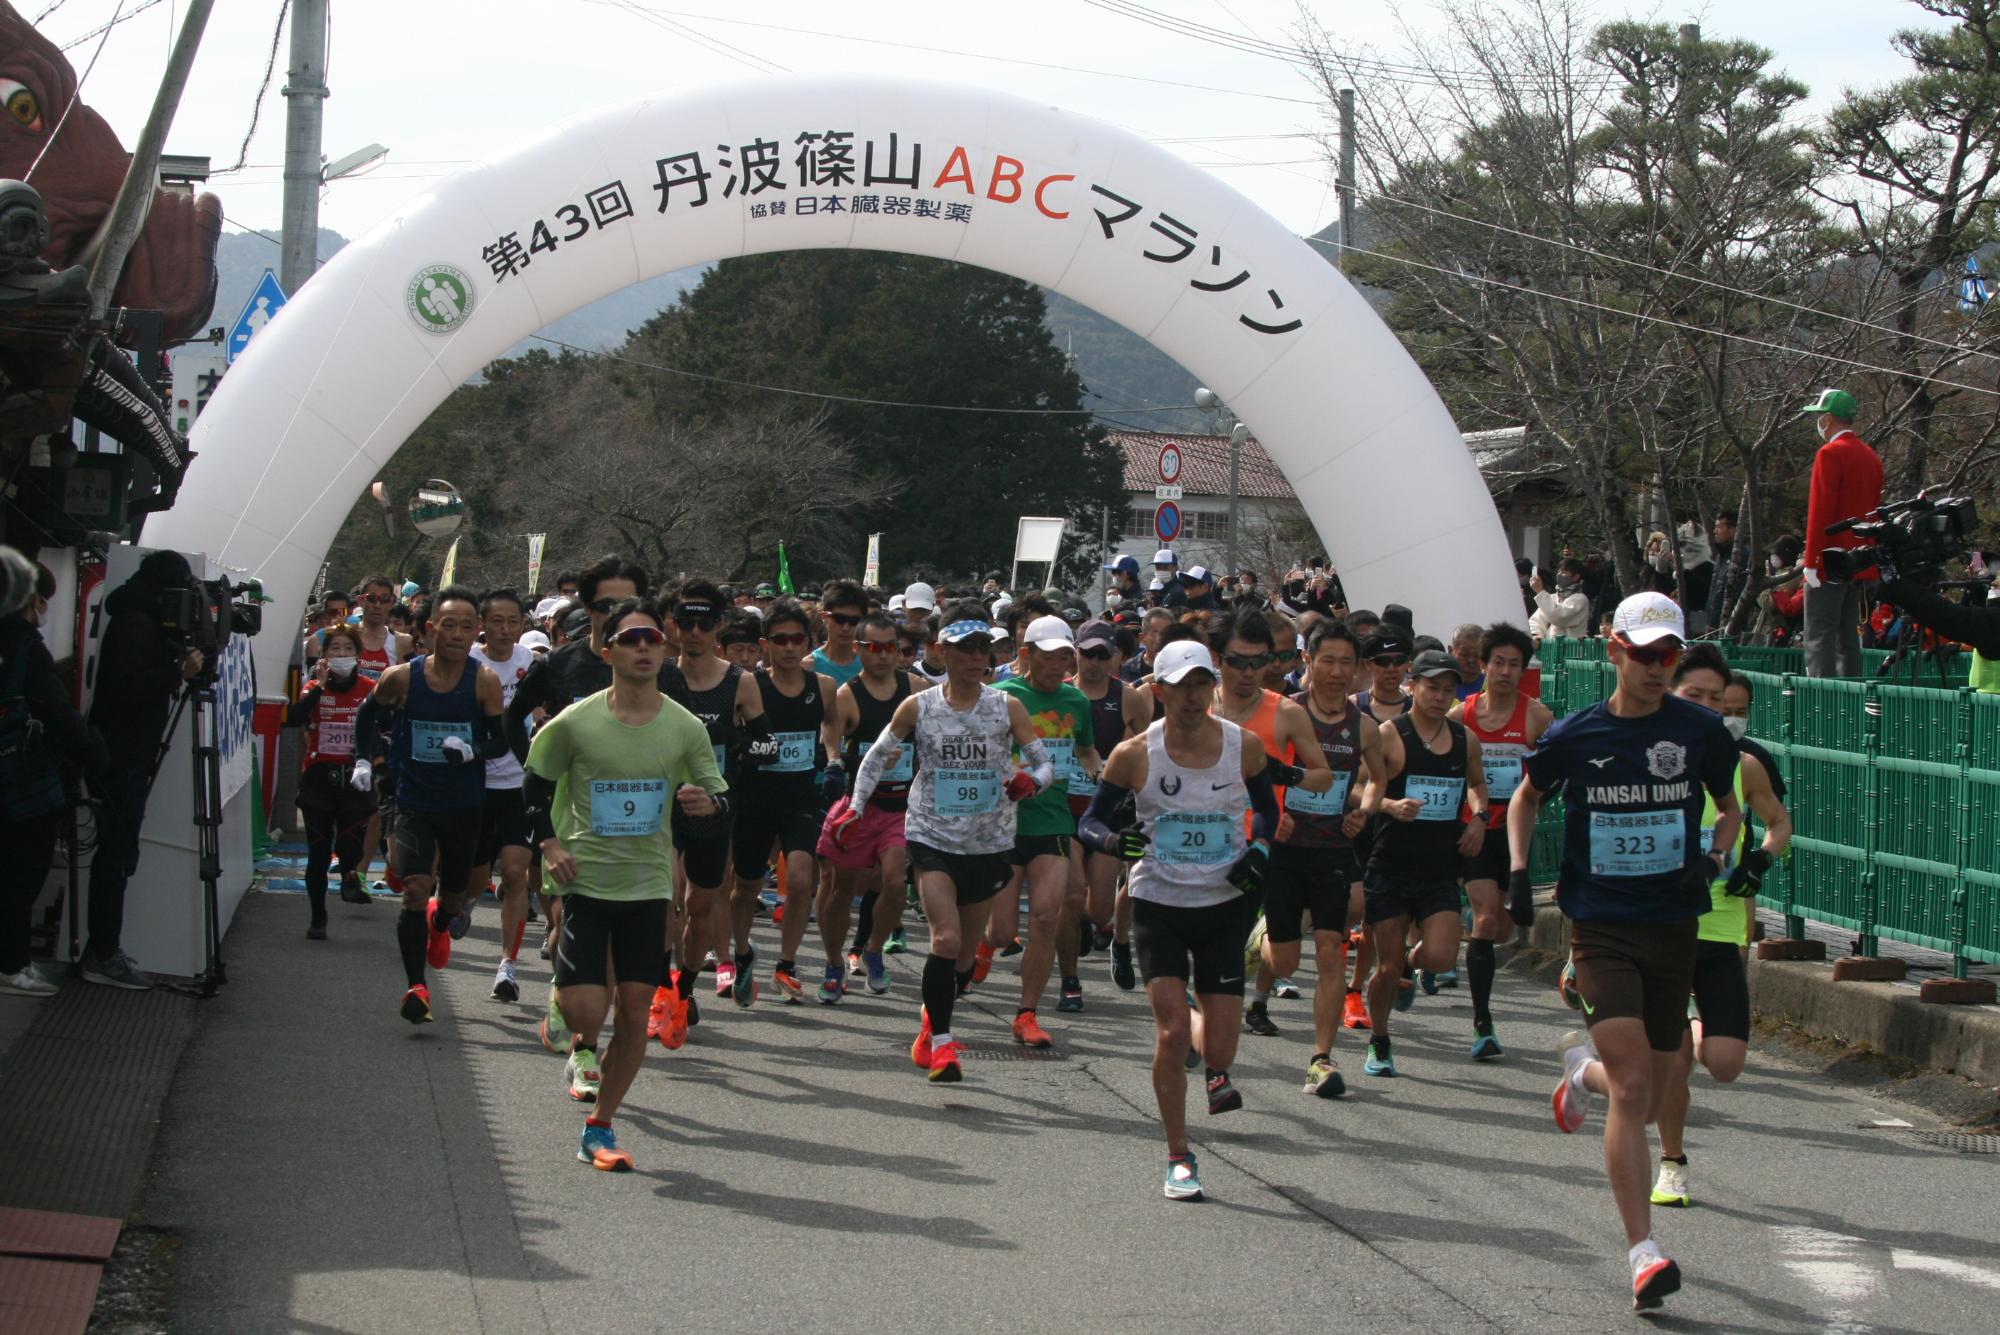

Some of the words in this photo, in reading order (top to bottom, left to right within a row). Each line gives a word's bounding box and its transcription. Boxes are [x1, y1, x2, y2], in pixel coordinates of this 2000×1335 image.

[751, 201, 786, 219] 協賛
[795, 195, 973, 224] 日本臓器製薬
[481, 179, 634, 283] 第43回
[1163, 455, 1177, 473] 30
[942, 744, 987, 760] RUN
[957, 786, 978, 801] 98
[1422, 791, 1448, 806] 313
[1586, 784, 1647, 805] KANSAI
[1652, 781, 1692, 803] UNIV.
[623, 800, 636, 817] 9
[1181, 831, 1206, 847] 20
[1613, 835, 1656, 855] 323
